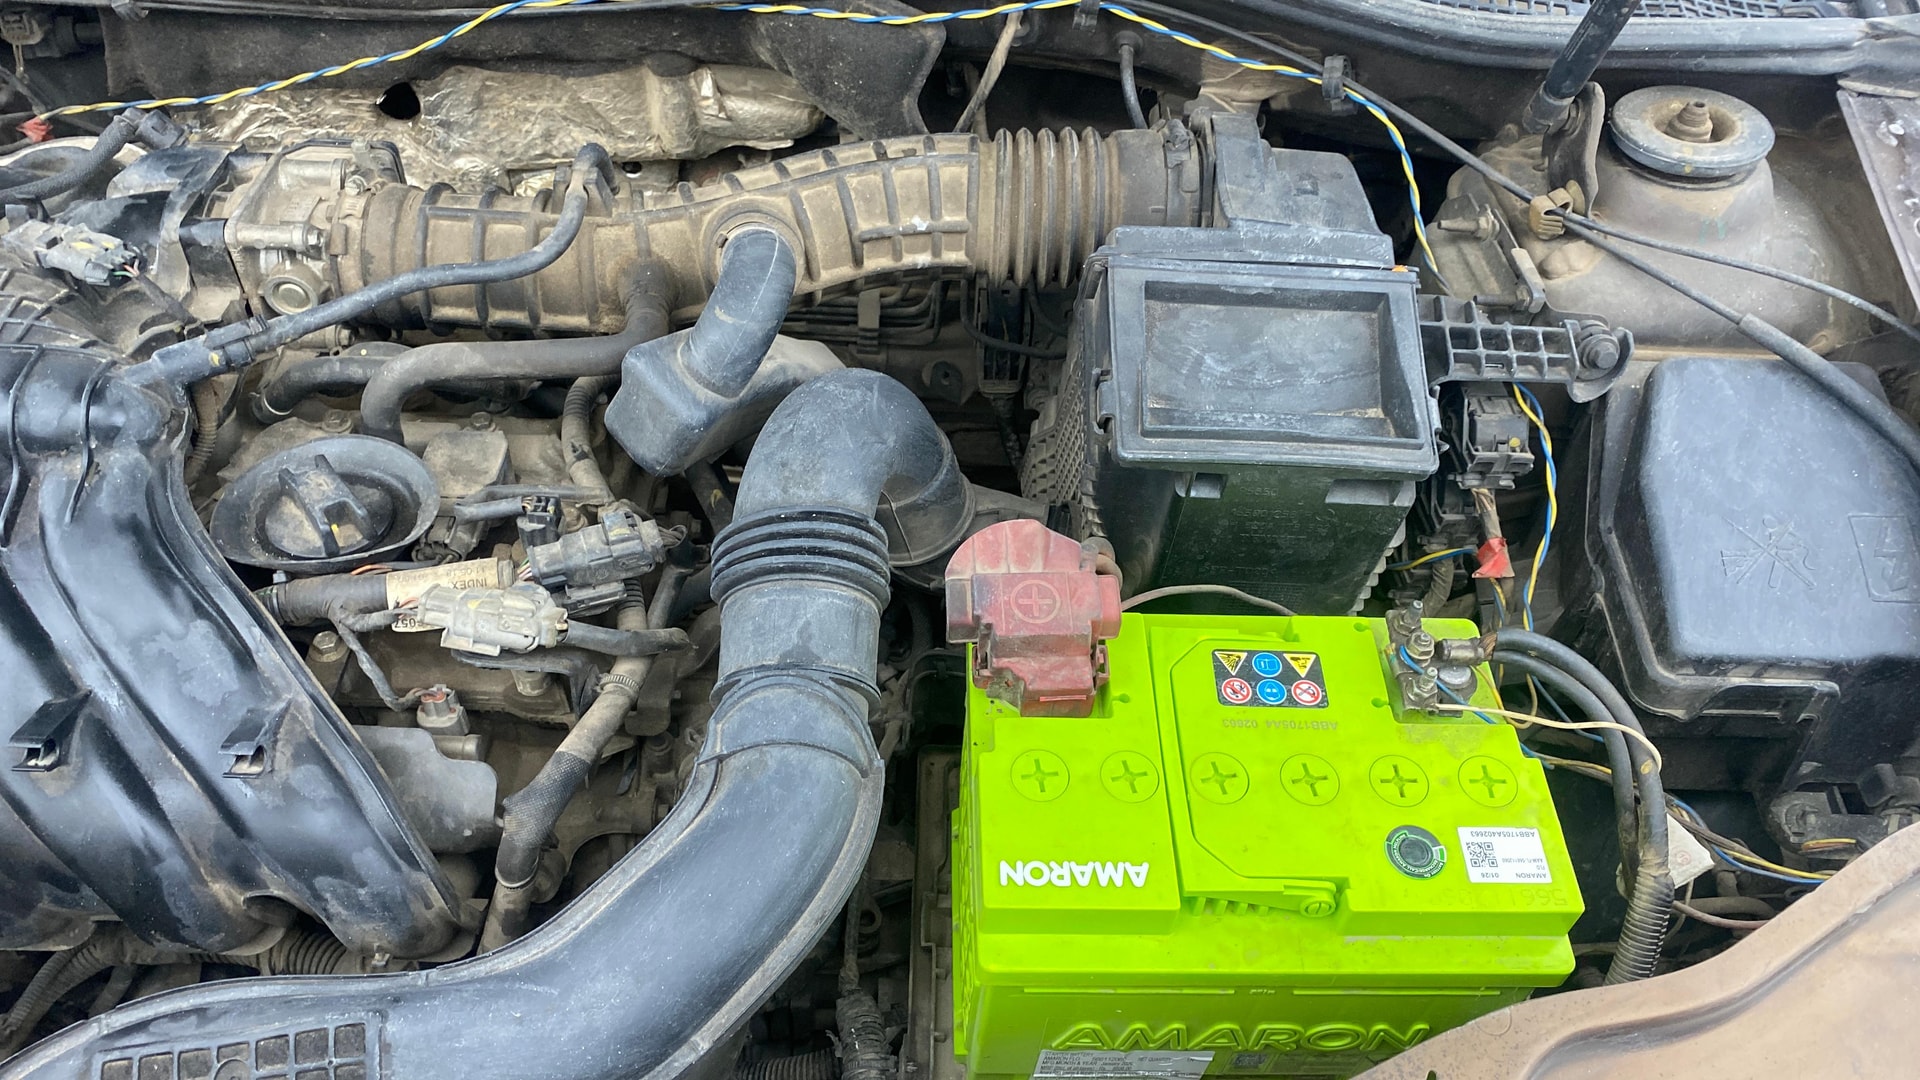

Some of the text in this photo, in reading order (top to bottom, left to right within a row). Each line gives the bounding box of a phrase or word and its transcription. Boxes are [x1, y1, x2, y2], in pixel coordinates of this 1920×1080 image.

[451, 578, 487, 590] INDEX
[999, 860, 1150, 889] AMARON
[1052, 1022, 1430, 1050] AMARON
